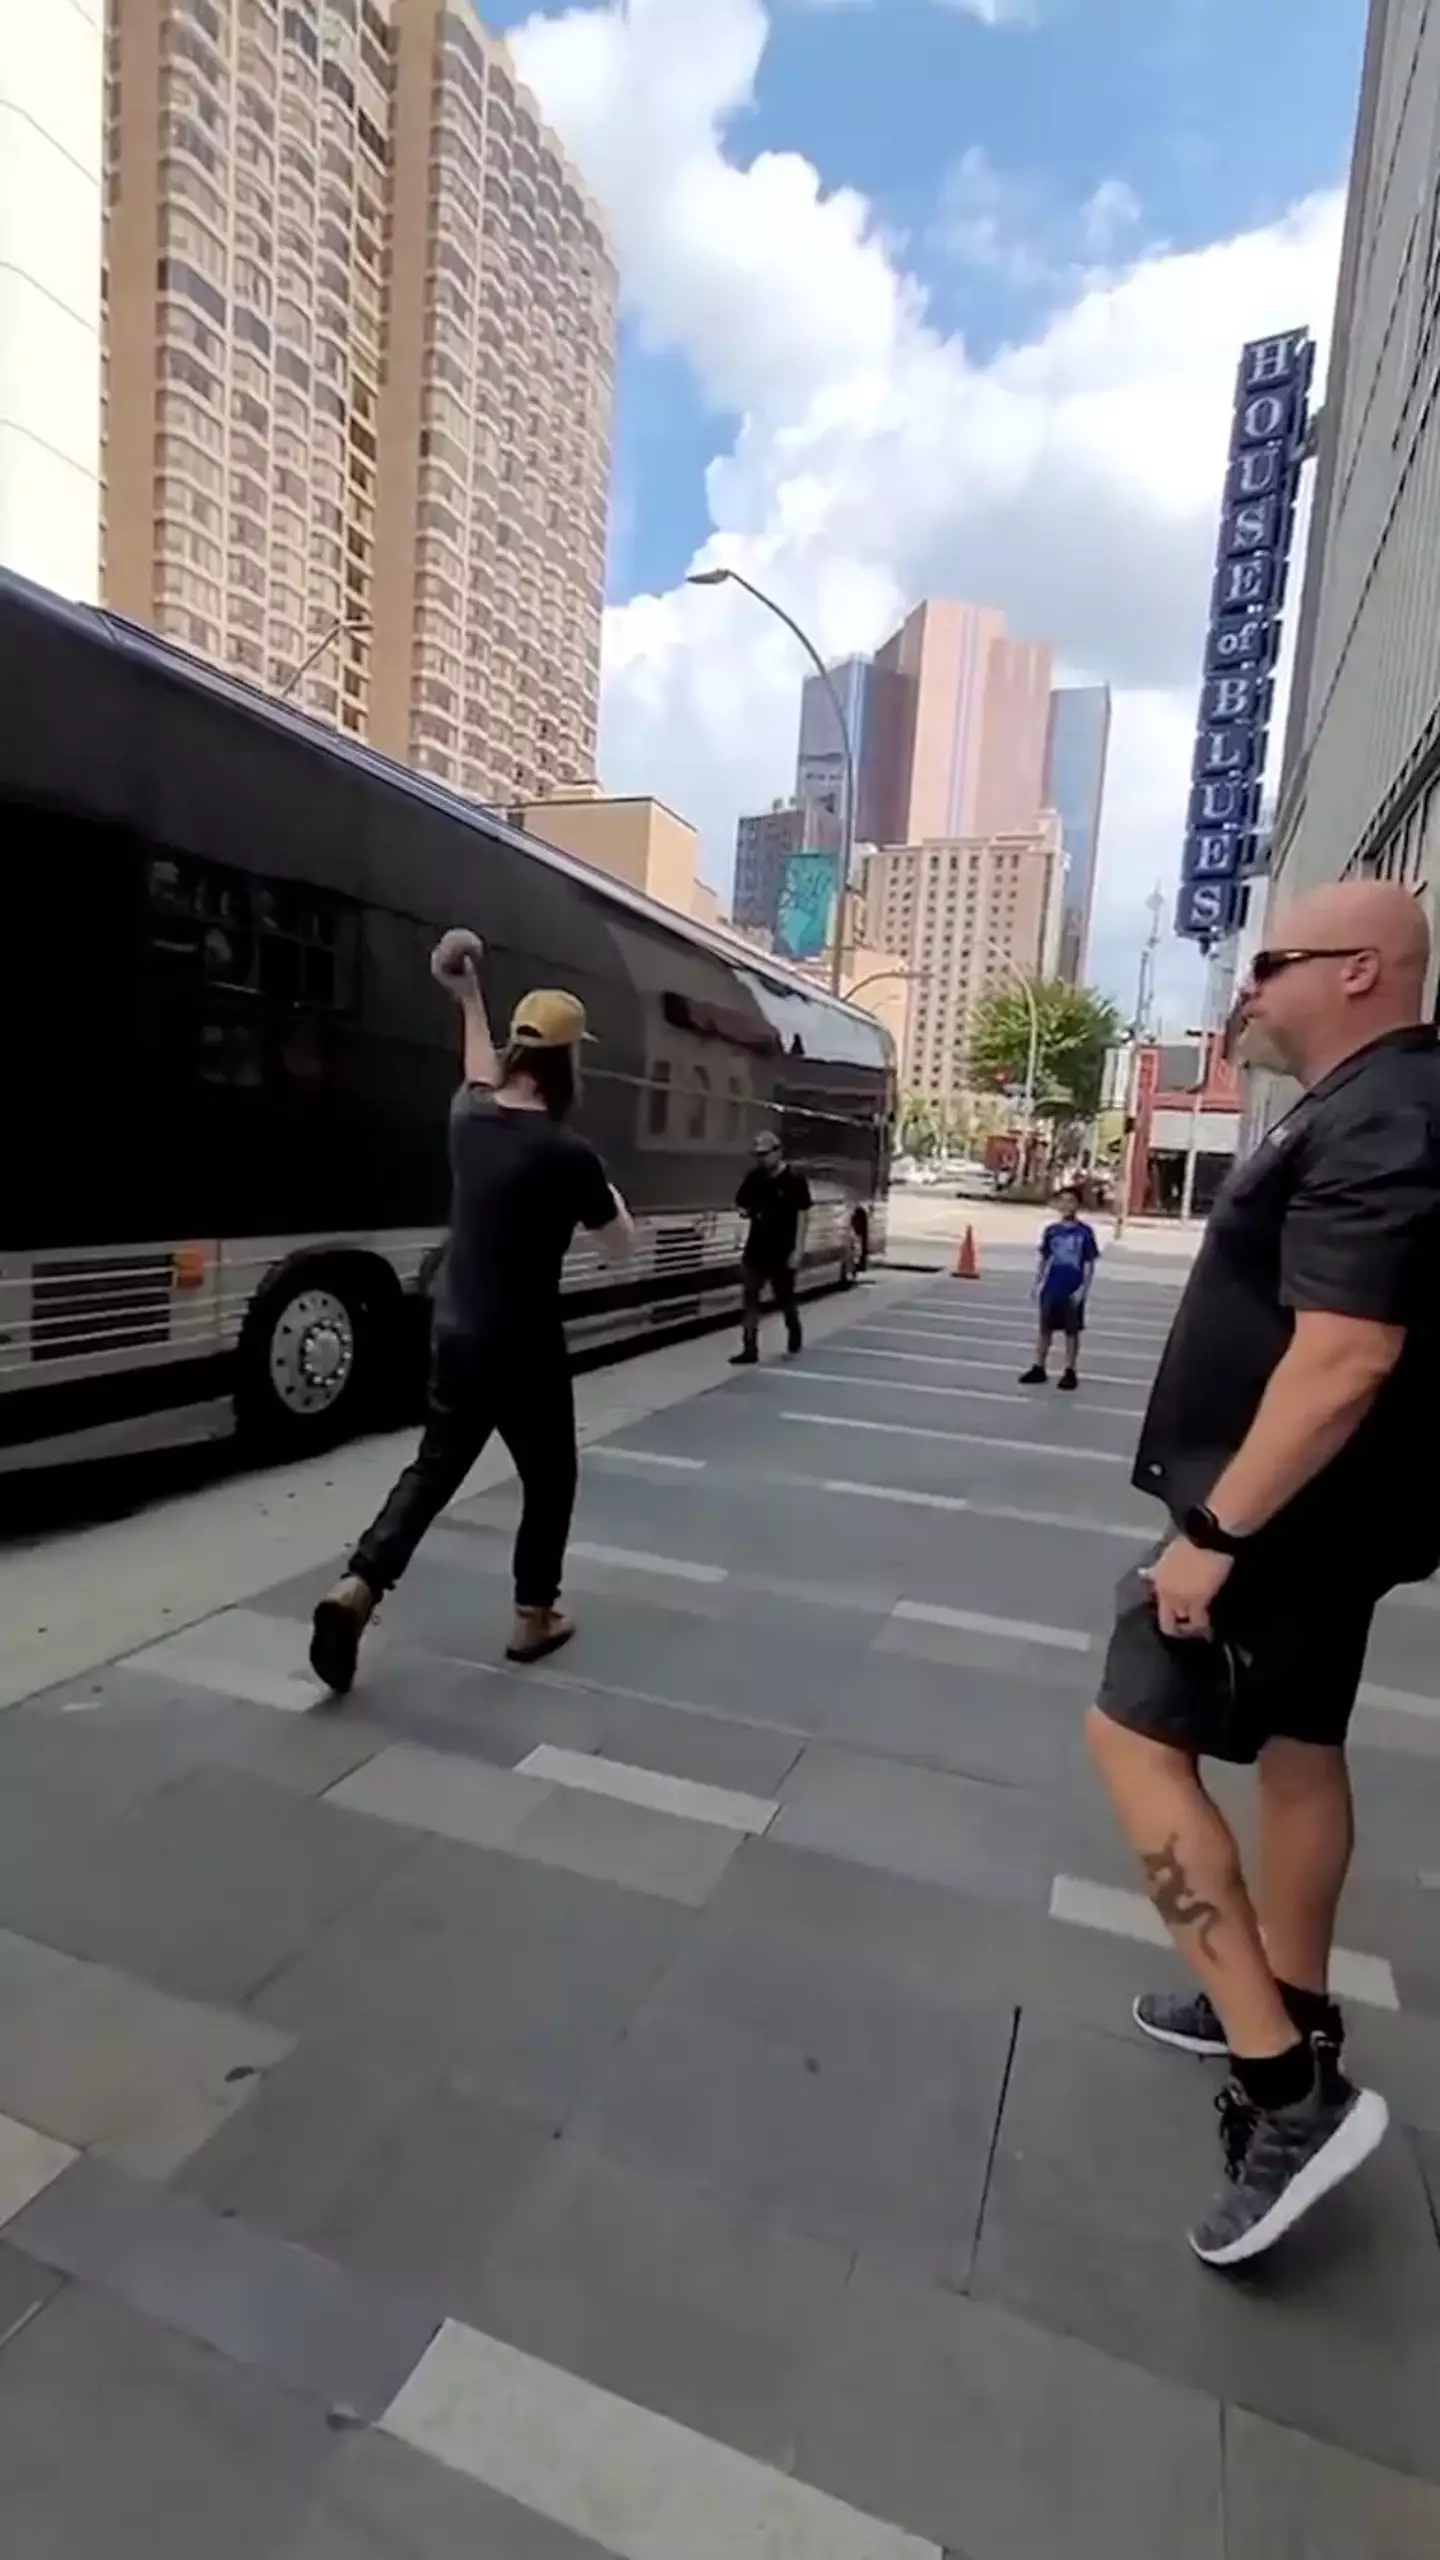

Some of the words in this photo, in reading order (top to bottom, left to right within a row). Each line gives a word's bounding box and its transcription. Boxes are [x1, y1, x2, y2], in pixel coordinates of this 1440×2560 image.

[1226, 336, 1294, 601] HOUSE
[1217, 621, 1257, 655] of
[1190, 677, 1249, 922] BLUES
